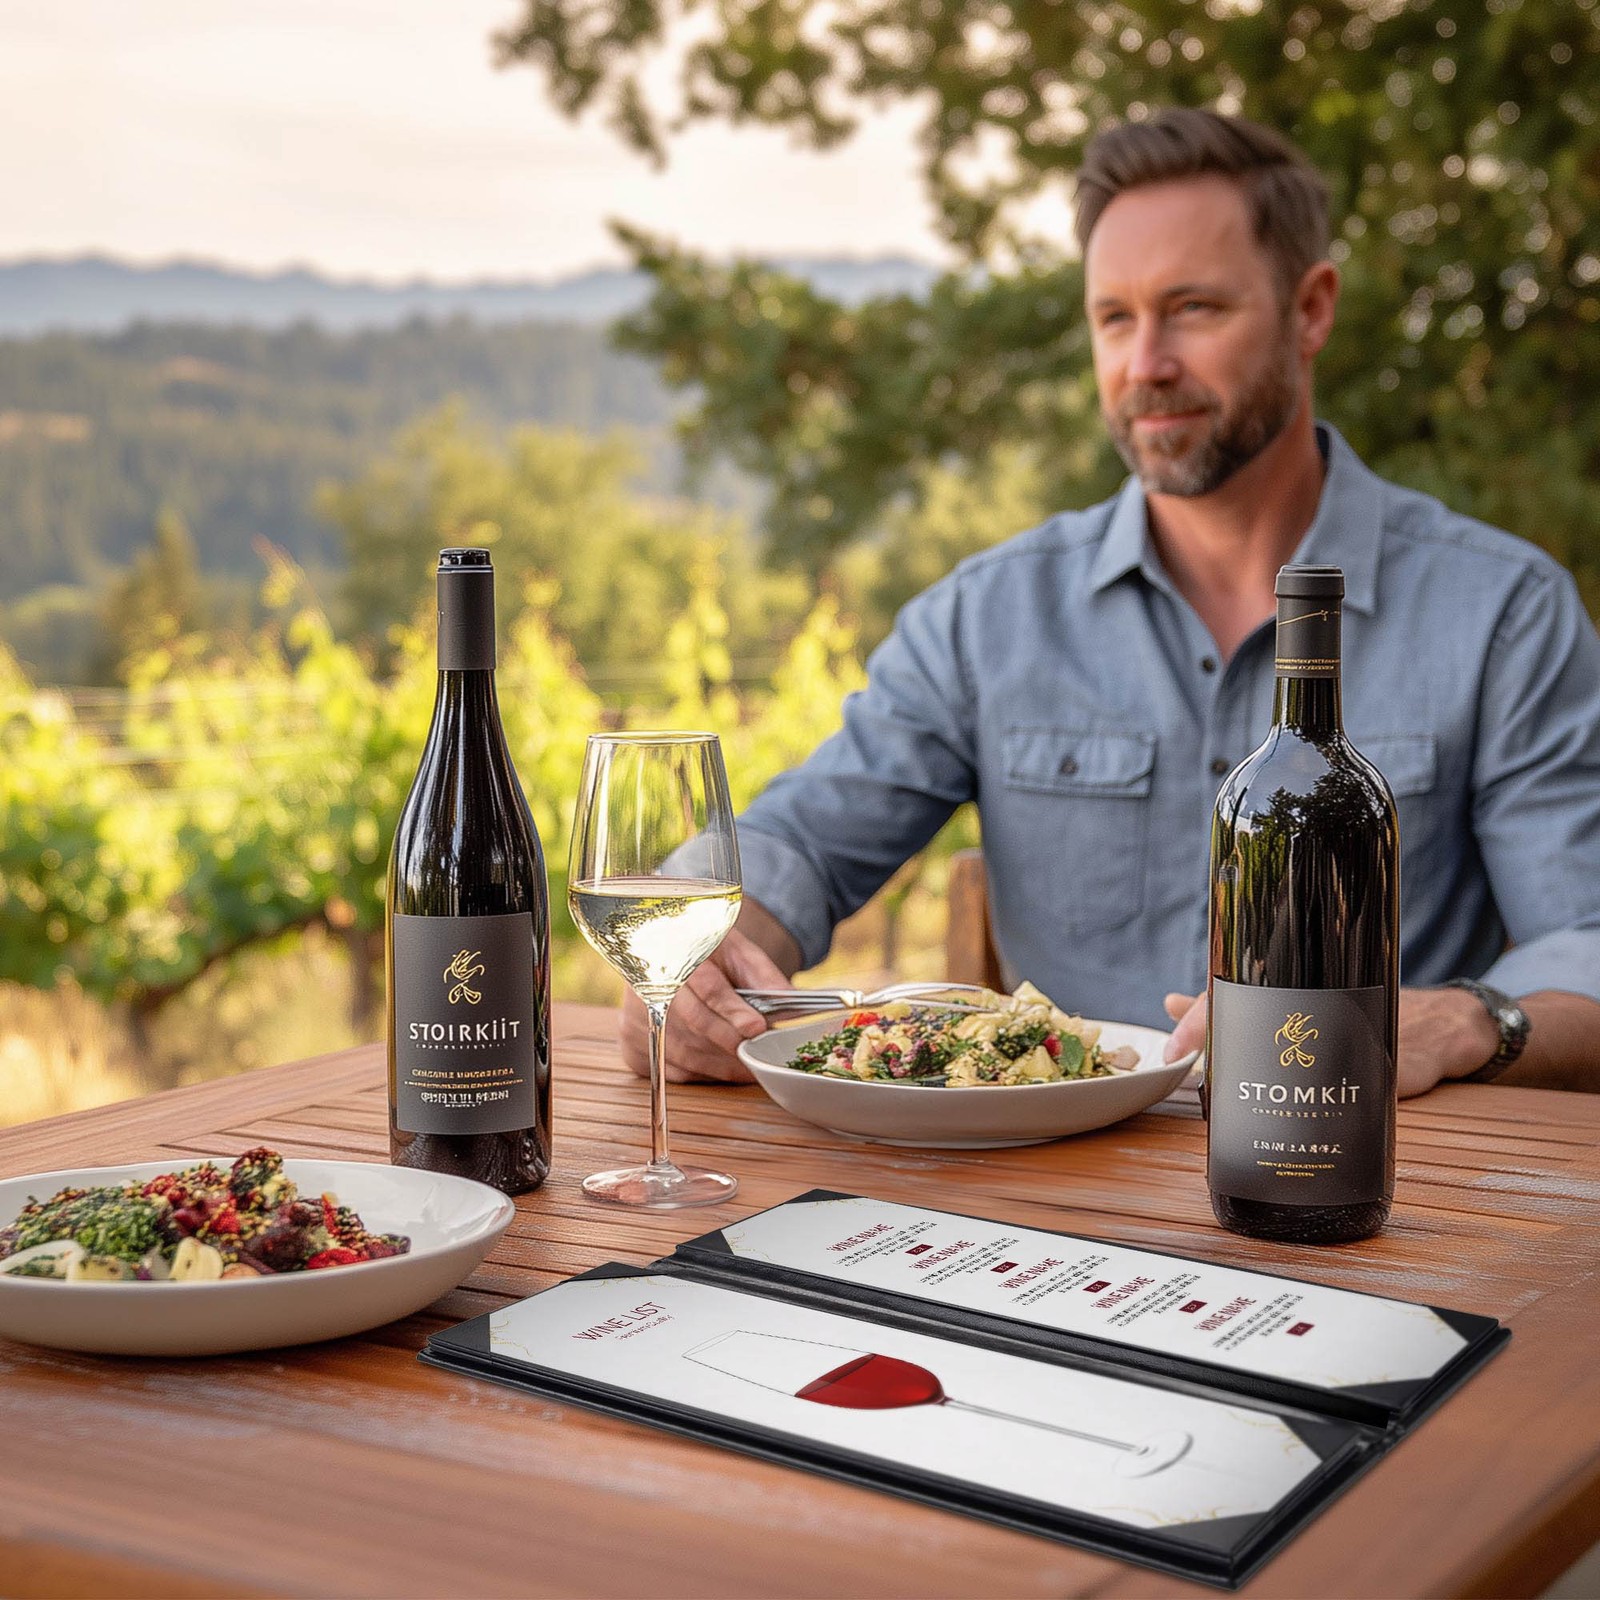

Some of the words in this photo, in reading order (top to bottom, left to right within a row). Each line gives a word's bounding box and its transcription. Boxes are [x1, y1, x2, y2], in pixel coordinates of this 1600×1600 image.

[825, 1234, 863, 1252] WINE
[908, 1251, 948, 1270] WINE
[998, 1272, 1038, 1289] WINE
[1090, 1291, 1130, 1309] WINE
[572, 1317, 633, 1340] WINE
[621, 1302, 666, 1320] LIST
[1192, 1310, 1233, 1332] WINE
